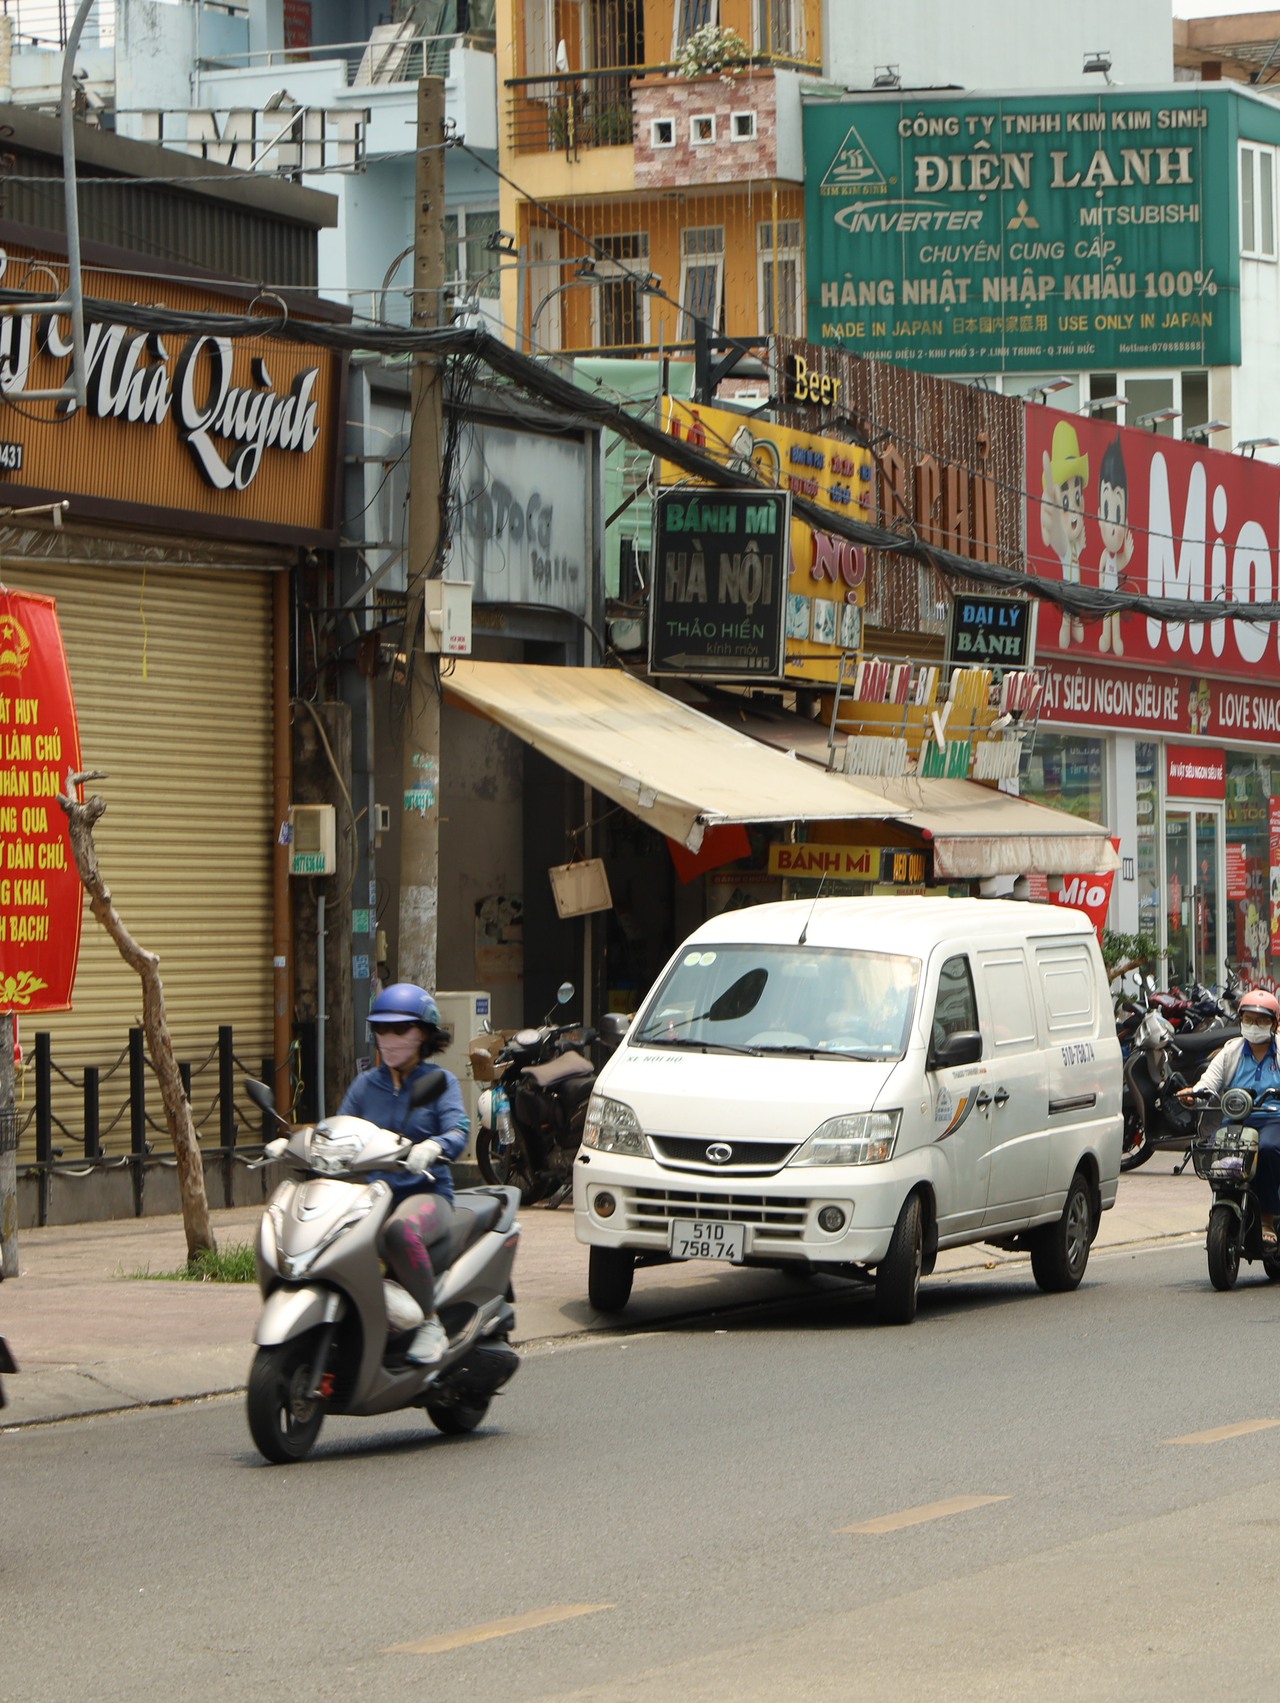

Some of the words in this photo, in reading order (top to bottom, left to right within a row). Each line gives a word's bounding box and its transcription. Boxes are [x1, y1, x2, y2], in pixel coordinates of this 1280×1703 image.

[899, 111, 959, 138] CÔNG
[965, 115, 996, 134] TY
[1003, 113, 1061, 134] TNHH
[1066, 112, 1106, 132] KIM
[1112, 111, 1151, 131] KIM
[1156, 109, 1208, 129] SINH
[914, 140, 1035, 201] ĐIỆN
[1050, 146, 1194, 197] LẠNH
[820, 186, 839, 196] KIM
[841, 186, 861, 196] KIM
[848, 209, 983, 233] INVERTER
[1080, 203, 1200, 227] MITSUBISHI
[919, 240, 1000, 264] CHUYÊN
[1009, 242, 1065, 260] CUNG
[1074, 232, 1116, 259] CẤP
[821, 272, 894, 308] HÀNG
[902, 270, 971, 312] NHẬT
[983, 268, 1056, 309] NHẬP
[1064, 256, 1136, 301] KHẨU
[1145, 268, 1218, 298] 100%
[821, 321, 866, 338] MADE
[871, 320, 887, 337] IN
[890, 319, 943, 337] JAPAN
[1058, 315, 1089, 332] USE
[1094, 313, 1134, 331] ONLY
[1139, 313, 1155, 330] IN
[1159, 311, 1213, 329] JAPAN
[895, 347, 916, 360] DIỆU
[948, 344, 968, 358] PHỐ
[1077, 342, 1096, 355] ĐỨC
[794, 354, 842, 404] Beer
[178, 334, 321, 491] Quỳnh
[666, 498, 738, 533] BÁNH
[745, 498, 777, 535] MÌ
[665, 539, 708, 602] HÀ
[718, 541, 774, 615] NỘI
[666, 617, 718, 640] THẢO
[962, 604, 994, 628] ĐẠI
[999, 602, 1021, 627] LÝ
[706, 641, 733, 655] kính
[957, 627, 1022, 657] BÁNH
[15, 698, 39, 725] HUY
[1063, 667, 1093, 712] SIÊU
[1094, 678, 1134, 716] NGON
[1134, 675, 1163, 719] SIÊU
[1163, 677, 1180, 720] RẺ
[1219, 693, 1251, 729] LOVE
[5, 728, 32, 760] LÀM
[35, 727, 62, 761] CHỦ
[33, 765, 60, 797] DÂN
[22, 806, 48, 835] QUA
[7, 837, 35, 869] DÂN
[38, 834, 68, 872] CHỦ,
[777, 846, 841, 872] BÁNH
[846, 849, 871, 873] MÌ
[14, 879, 49, 908] KHAI,
[1058, 876, 1107, 908] Mio
[10, 915, 49, 947] BẠCH!
[1061, 1042, 1096, 1066] 51D-758.74
[692, 1221, 725, 1240] 51D
[678, 1240, 735, 1259] 758.74
